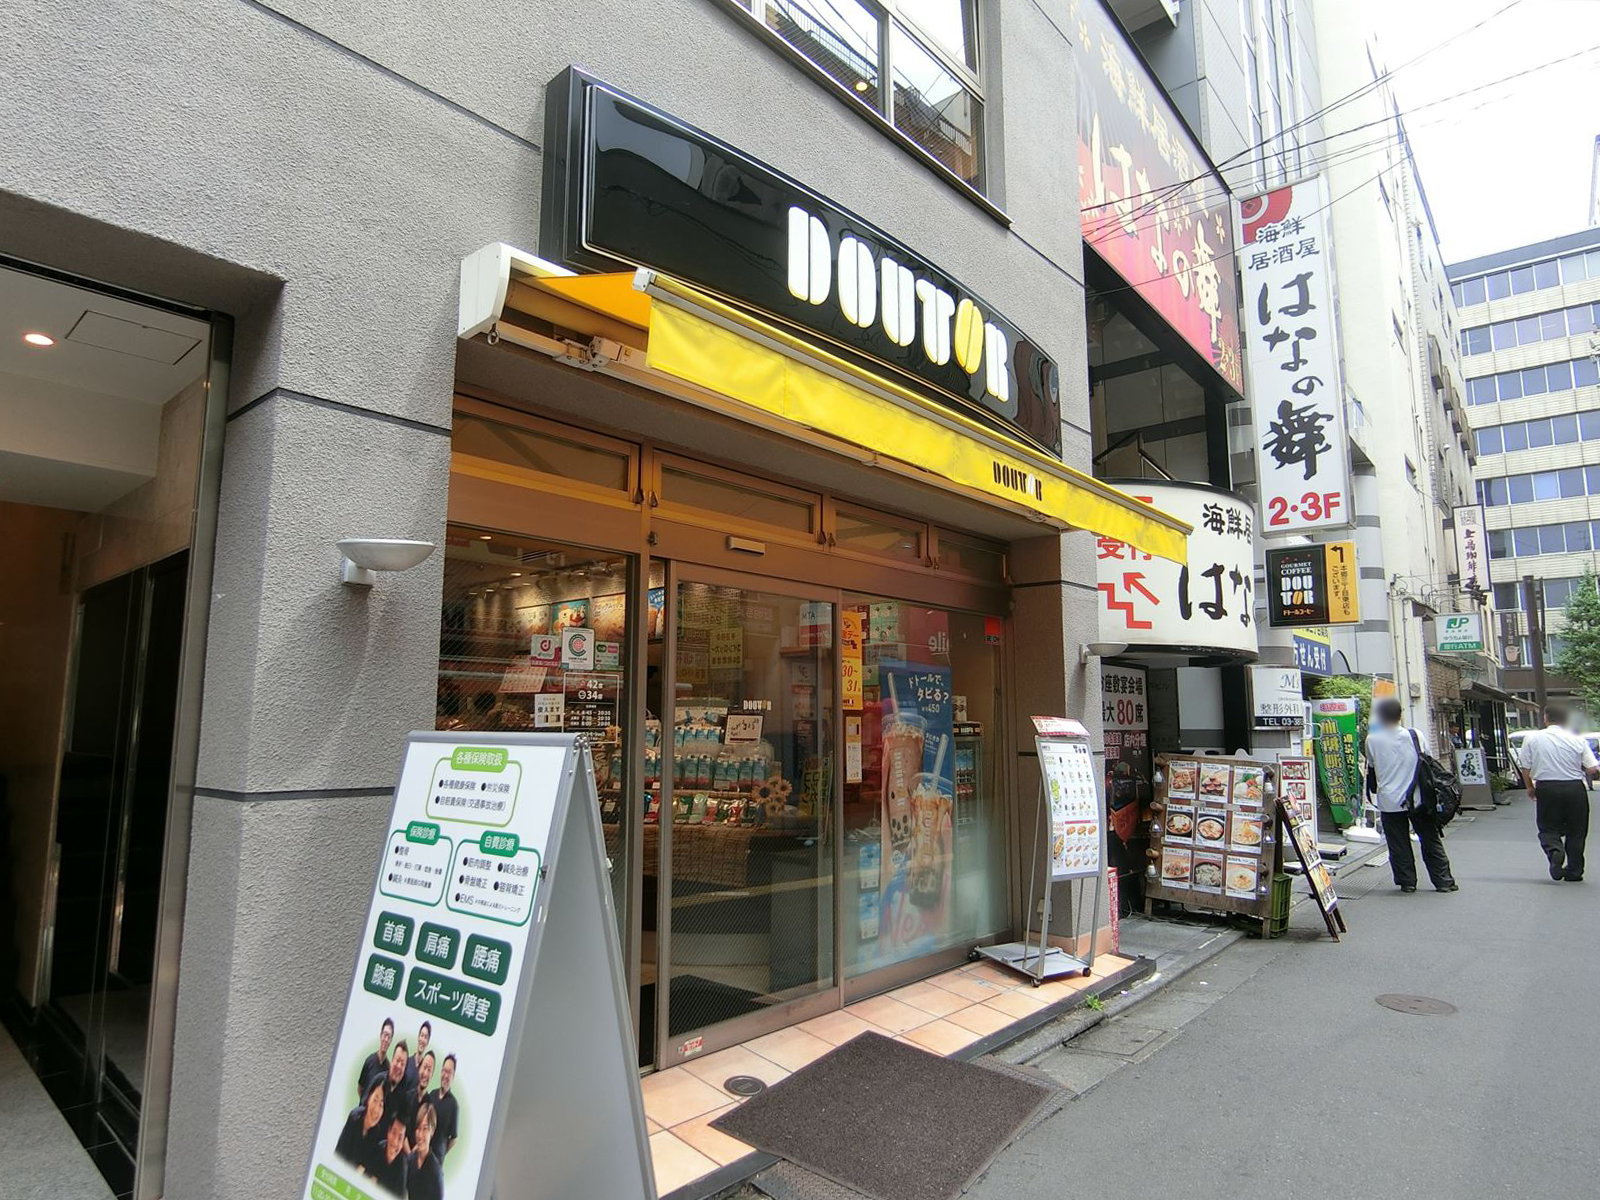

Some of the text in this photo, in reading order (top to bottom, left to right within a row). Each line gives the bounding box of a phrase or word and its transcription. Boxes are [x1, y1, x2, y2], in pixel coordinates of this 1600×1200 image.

[1257, 216, 1306, 243] 海鮮
[1248, 236, 1321, 271] 居酒屋
[787, 206, 1010, 403] DOUTOR
[1262, 271, 1335, 481] はなの舞
[992, 460, 1043, 502] DOUTOR
[1280, 561, 1312, 569] GOURMET
[1280, 567, 1313, 576] COFFEE
[1281, 575, 1313, 591] DOU
[1280, 590, 1314, 606] TOR
[1263, 718, 1280, 727] TEL
[484, 835, 516, 852] 自費診療
[463, 876, 488, 890] 骨盤矯正
[382, 920, 407, 946] 首痛
[423, 931, 452, 959] 肩痛
[470, 943, 502, 974] 腰痛
[370, 963, 397, 991] 膝痛
[413, 978, 491, 1023] スポーツ障害
